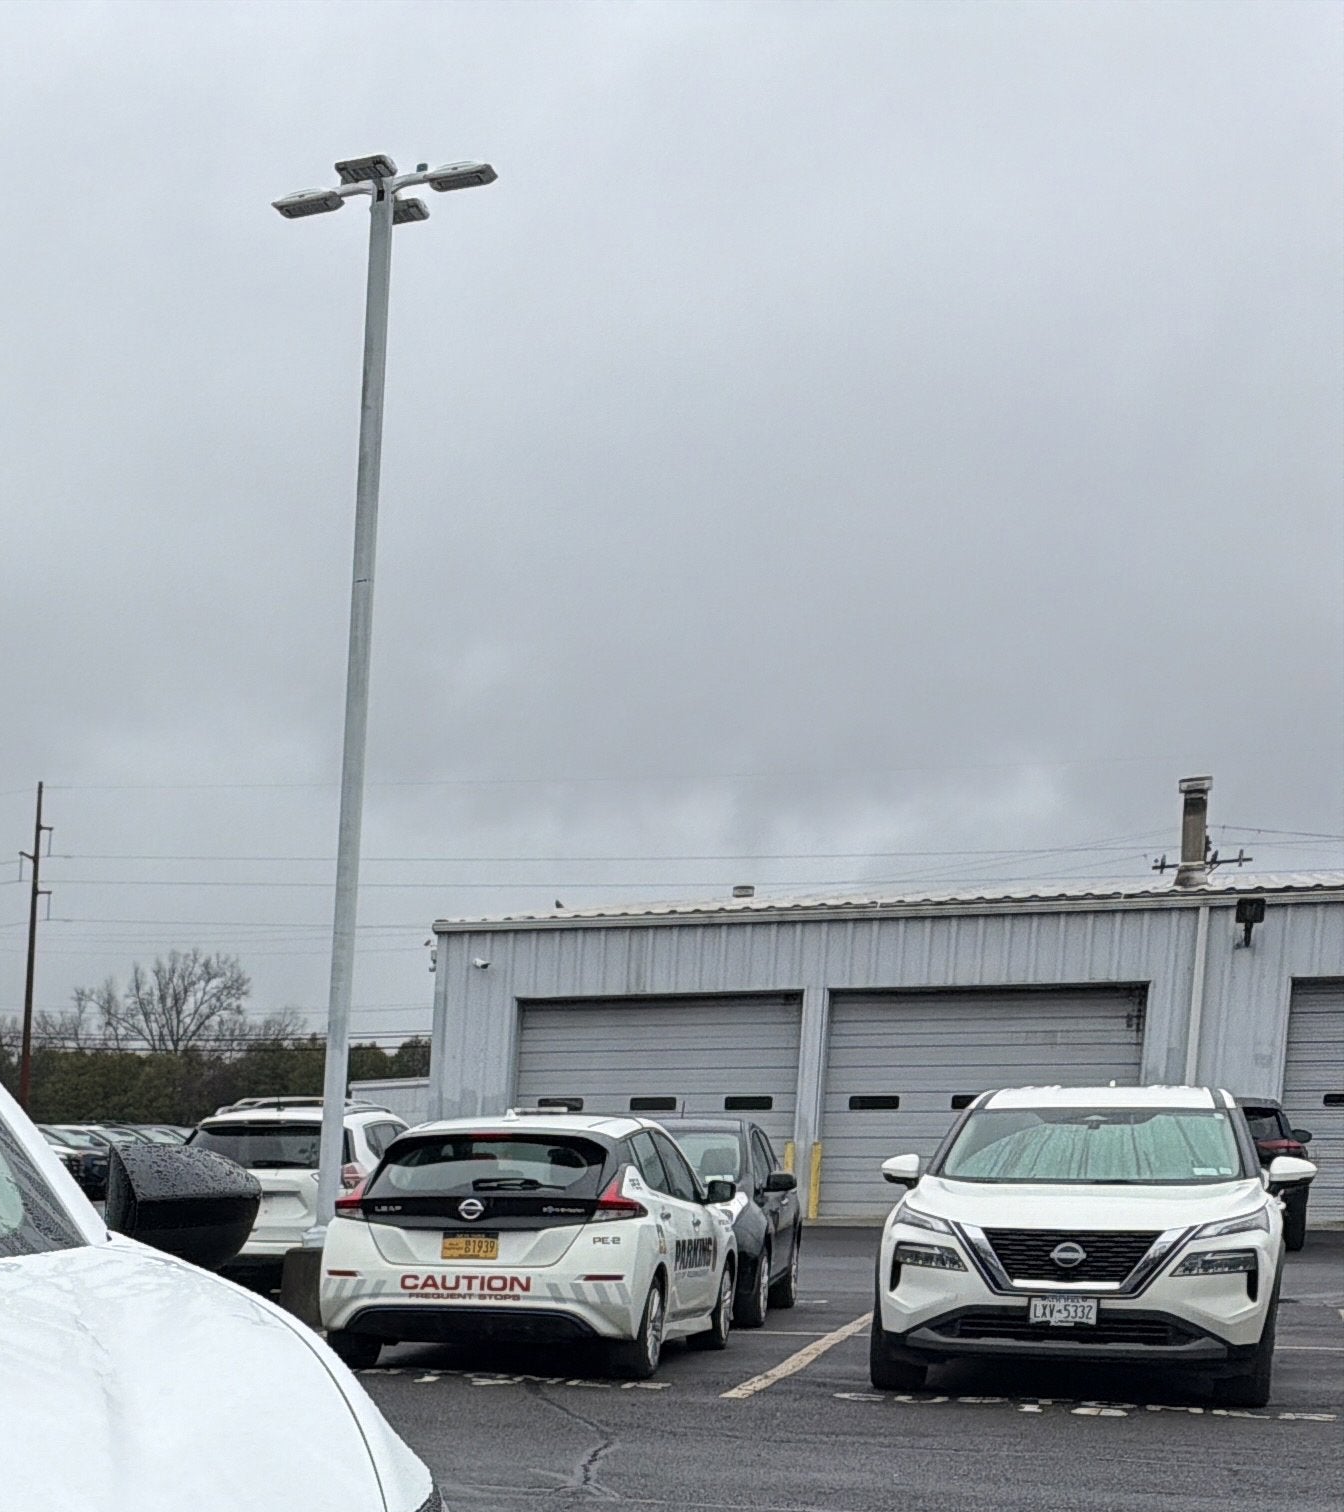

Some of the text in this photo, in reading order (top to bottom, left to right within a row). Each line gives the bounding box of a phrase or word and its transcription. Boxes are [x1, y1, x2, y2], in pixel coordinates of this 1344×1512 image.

[400, 1274, 531, 1292] CAUTION
[408, 1292, 521, 1301] FREQUENT STOPS
